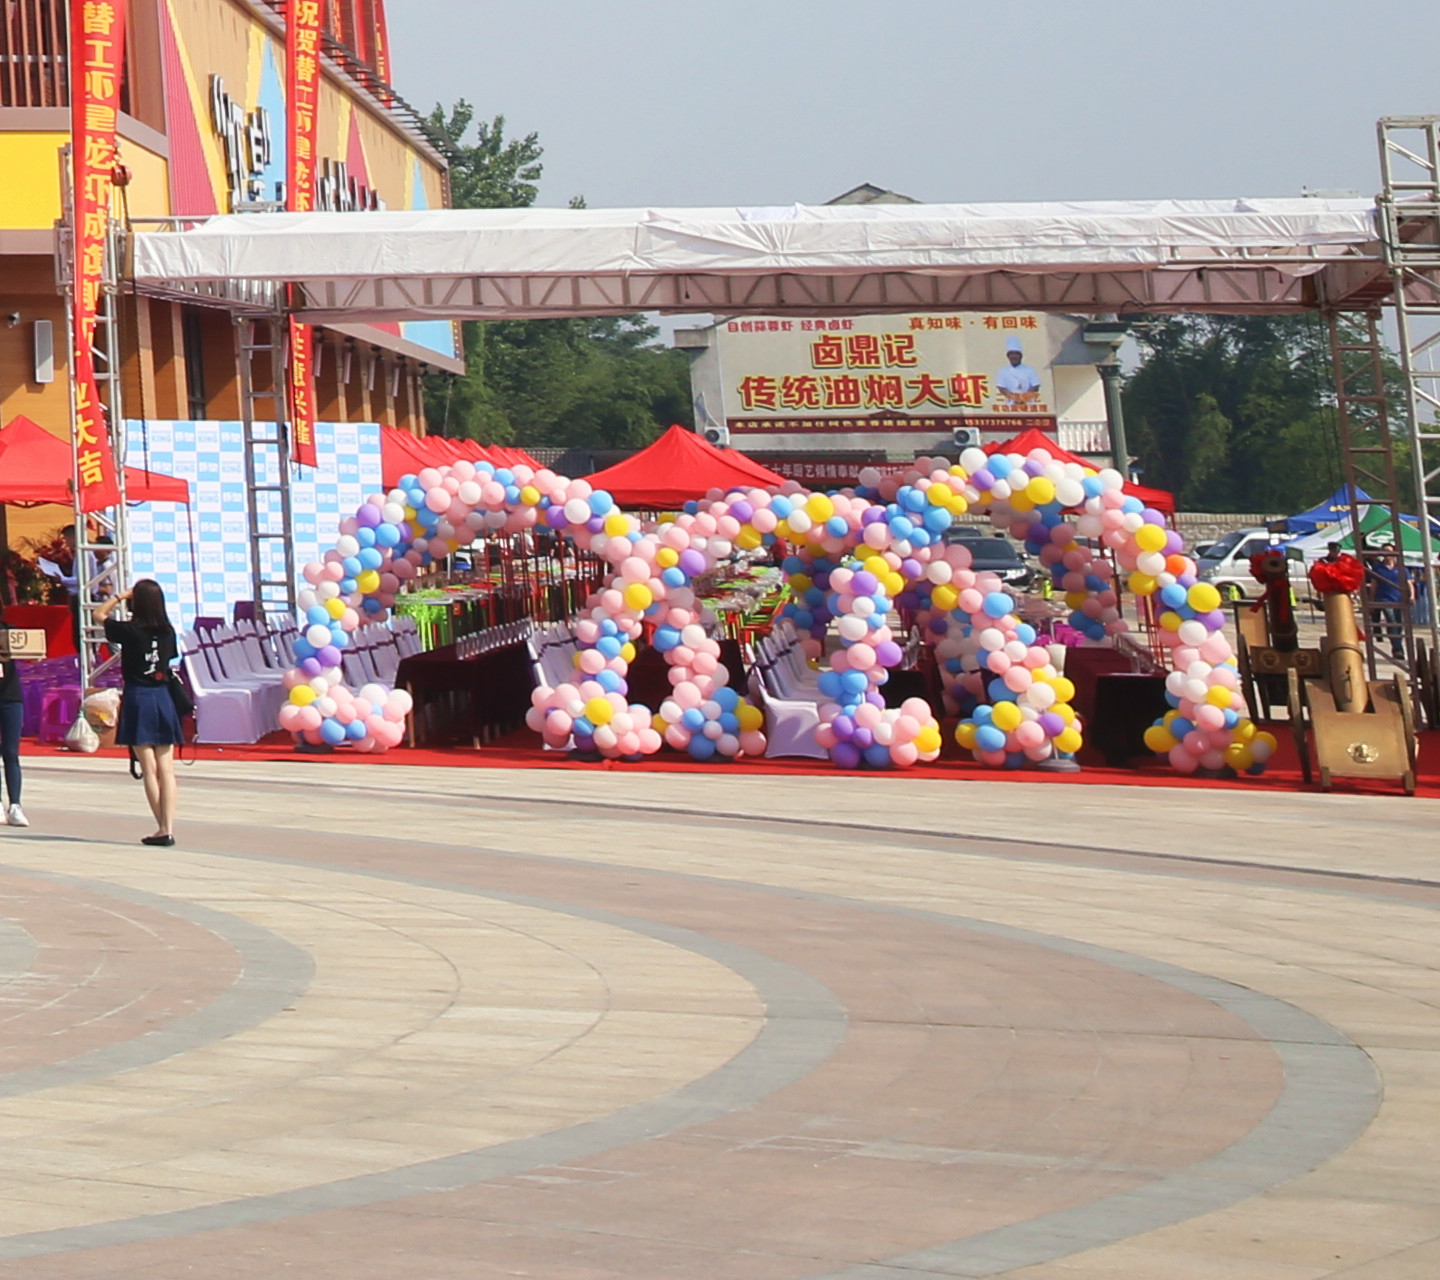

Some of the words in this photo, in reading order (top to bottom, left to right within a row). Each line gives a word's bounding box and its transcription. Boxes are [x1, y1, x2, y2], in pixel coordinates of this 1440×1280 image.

[812, 333, 918, 368] 卤鼎记
[738, 373, 989, 410] 传统油焖大虾
